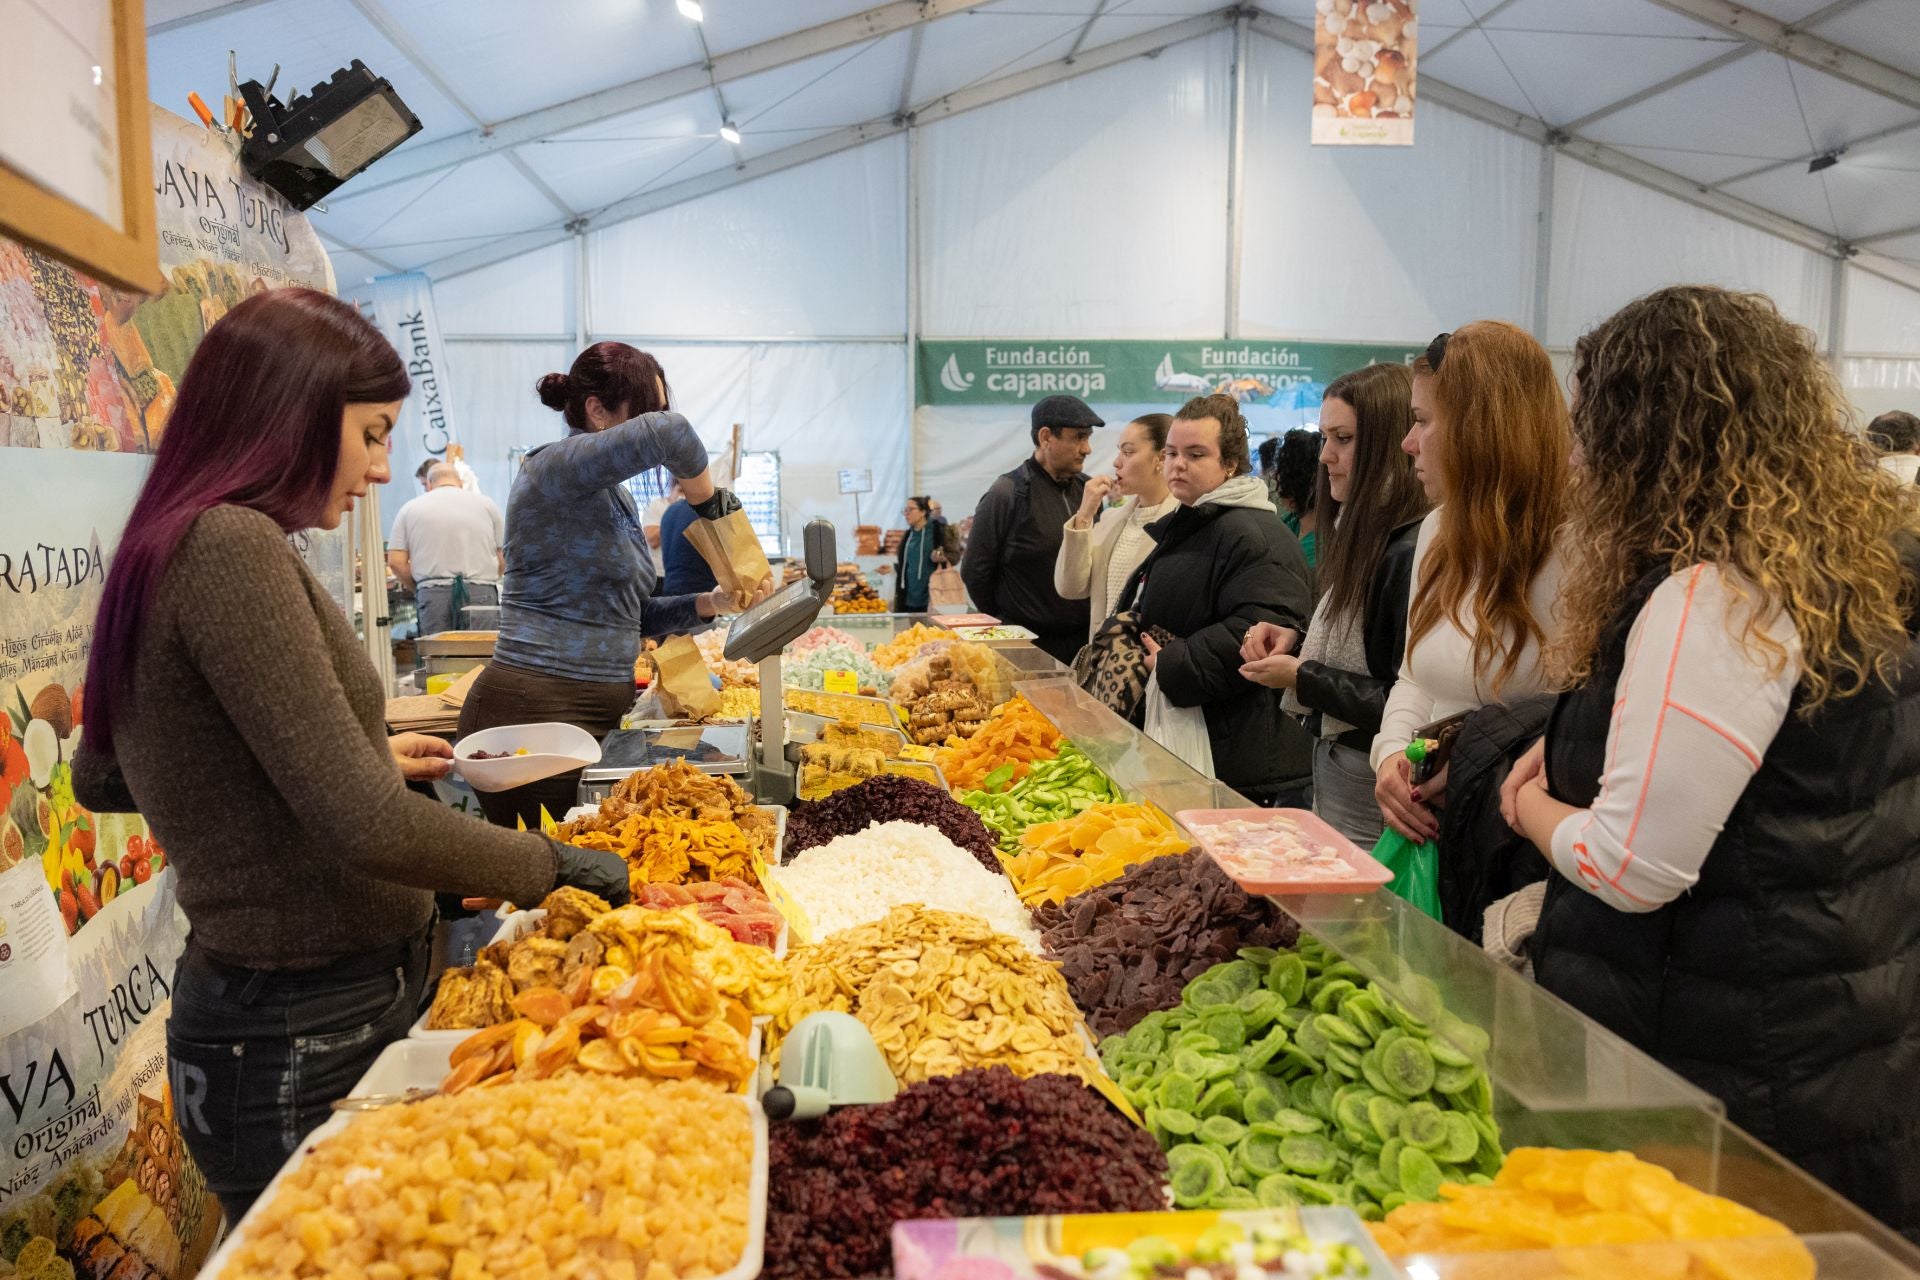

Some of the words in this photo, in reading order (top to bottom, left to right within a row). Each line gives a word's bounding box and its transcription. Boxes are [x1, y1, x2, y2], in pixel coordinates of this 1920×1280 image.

[199, 216, 240, 247] Original
[986, 346, 1090, 366] Fundación
[1202, 346, 1300, 366] Fundación
[398, 309, 450, 456] CaixaBank
[1, 636, 27, 658] Higos
[31, 629, 63, 650] Ciruelas
[66, 624, 83, 642] Aloe
[22, 652, 58, 672] Manzana
[83, 953, 171, 1068] TURCA
[14, 1083, 102, 1160] Original
[0, 1163, 40, 1203] Nuez
[50, 1112, 114, 1171] Anacardo
[116, 1088, 133, 1121] Miel
